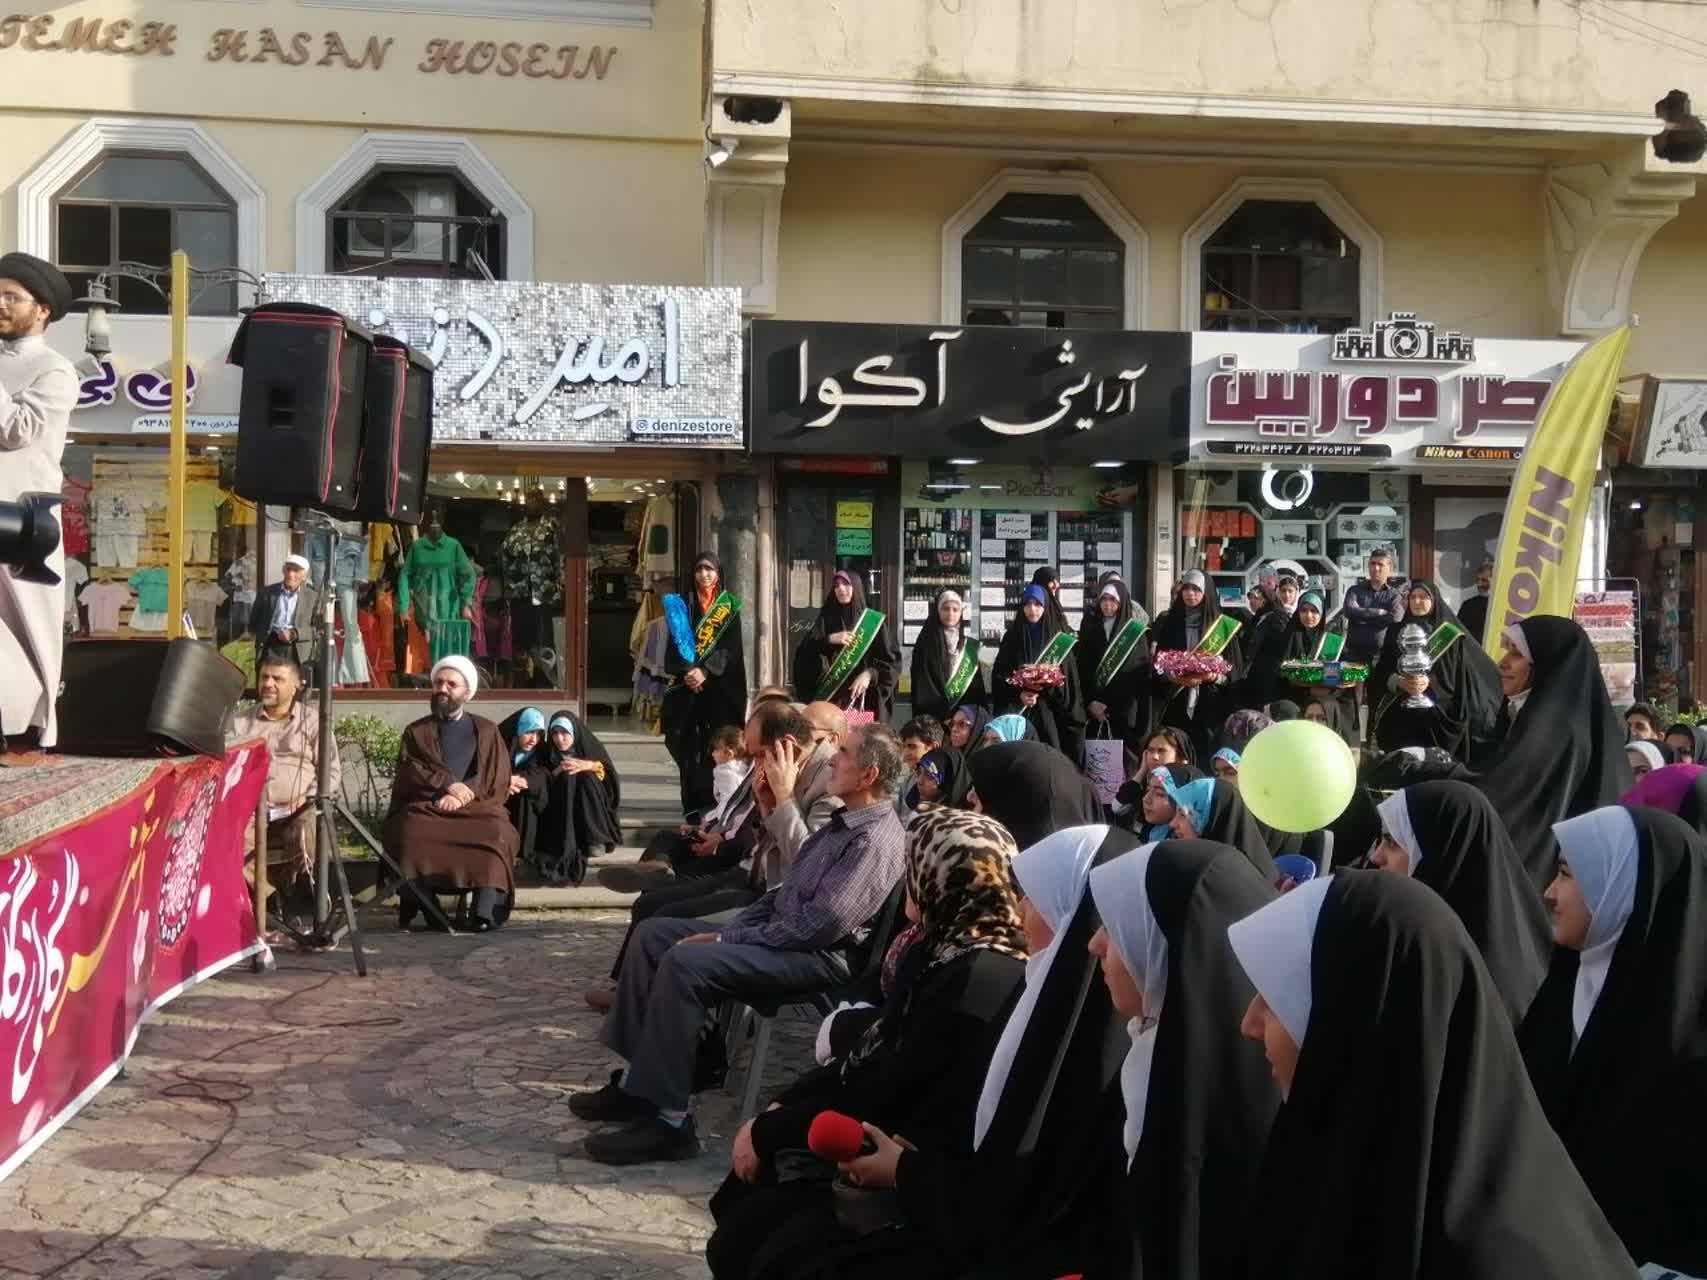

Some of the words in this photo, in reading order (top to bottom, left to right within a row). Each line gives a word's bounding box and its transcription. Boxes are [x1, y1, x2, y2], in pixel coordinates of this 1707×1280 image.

[206, 27, 394, 71] HASAN
[417, 37, 618, 81] HOSEIN
[514, 298, 681, 424] امیر
[799, 330, 963, 428] آکوا
[979, 338, 1148, 436] آرایشی
[1206, 353, 1440, 438] دوربین
[652, 418, 733, 432] denizestore
[1454, 374, 1553, 440] صر
[1424, 447, 1464, 458] Nikon
[1466, 448, 1510, 459] Canon
